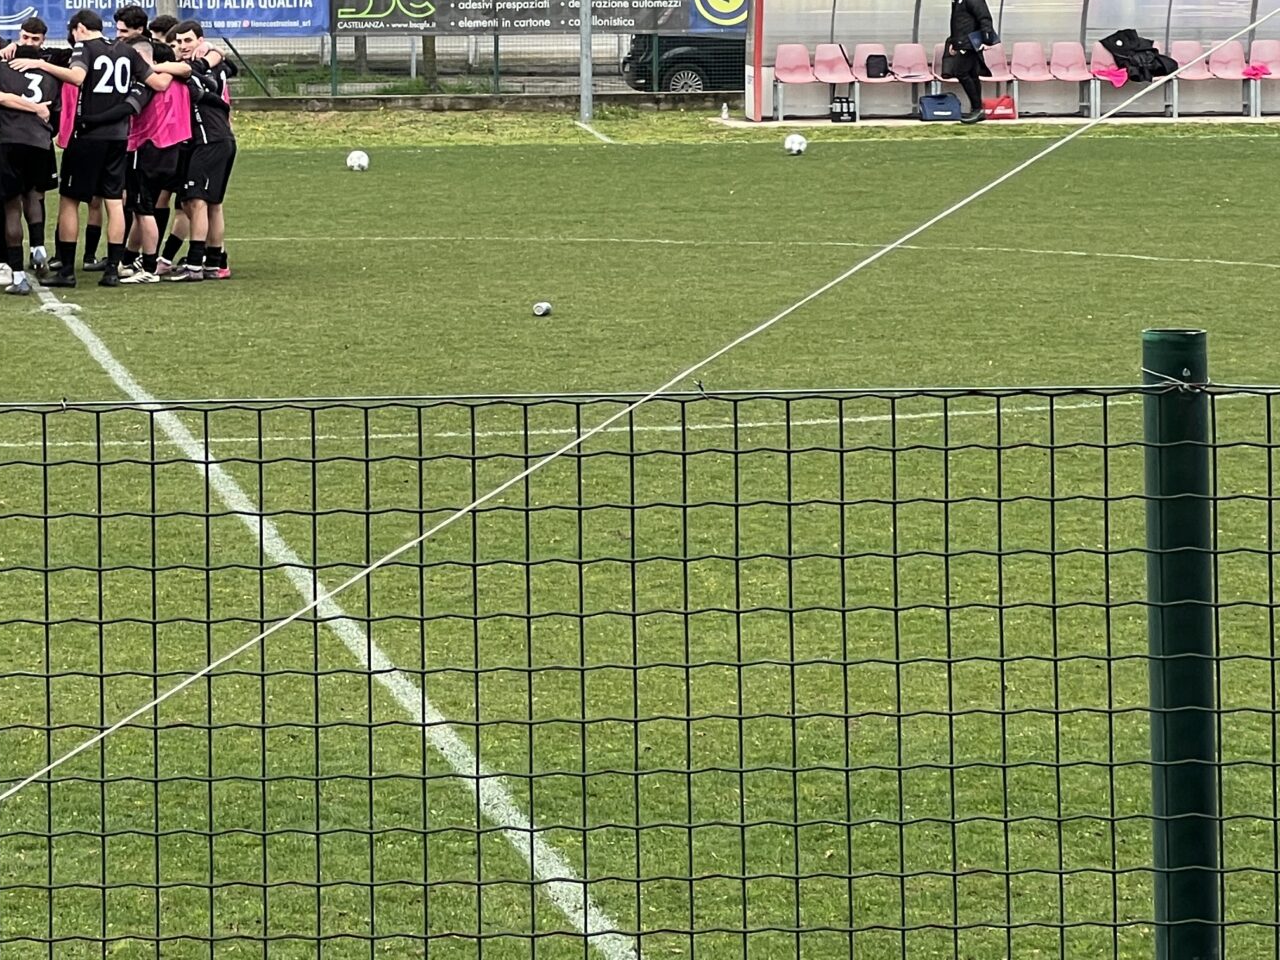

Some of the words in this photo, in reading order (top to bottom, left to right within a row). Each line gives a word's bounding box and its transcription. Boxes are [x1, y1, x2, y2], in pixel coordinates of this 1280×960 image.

[337, 21, 384, 29] CASTELLANZA
[458, 17, 499, 28] elementi
[502, 17, 511, 27] in
[514, 17, 551, 27] cartone
[93, 55, 131, 94] 20
[21, 72, 43, 103] 3
